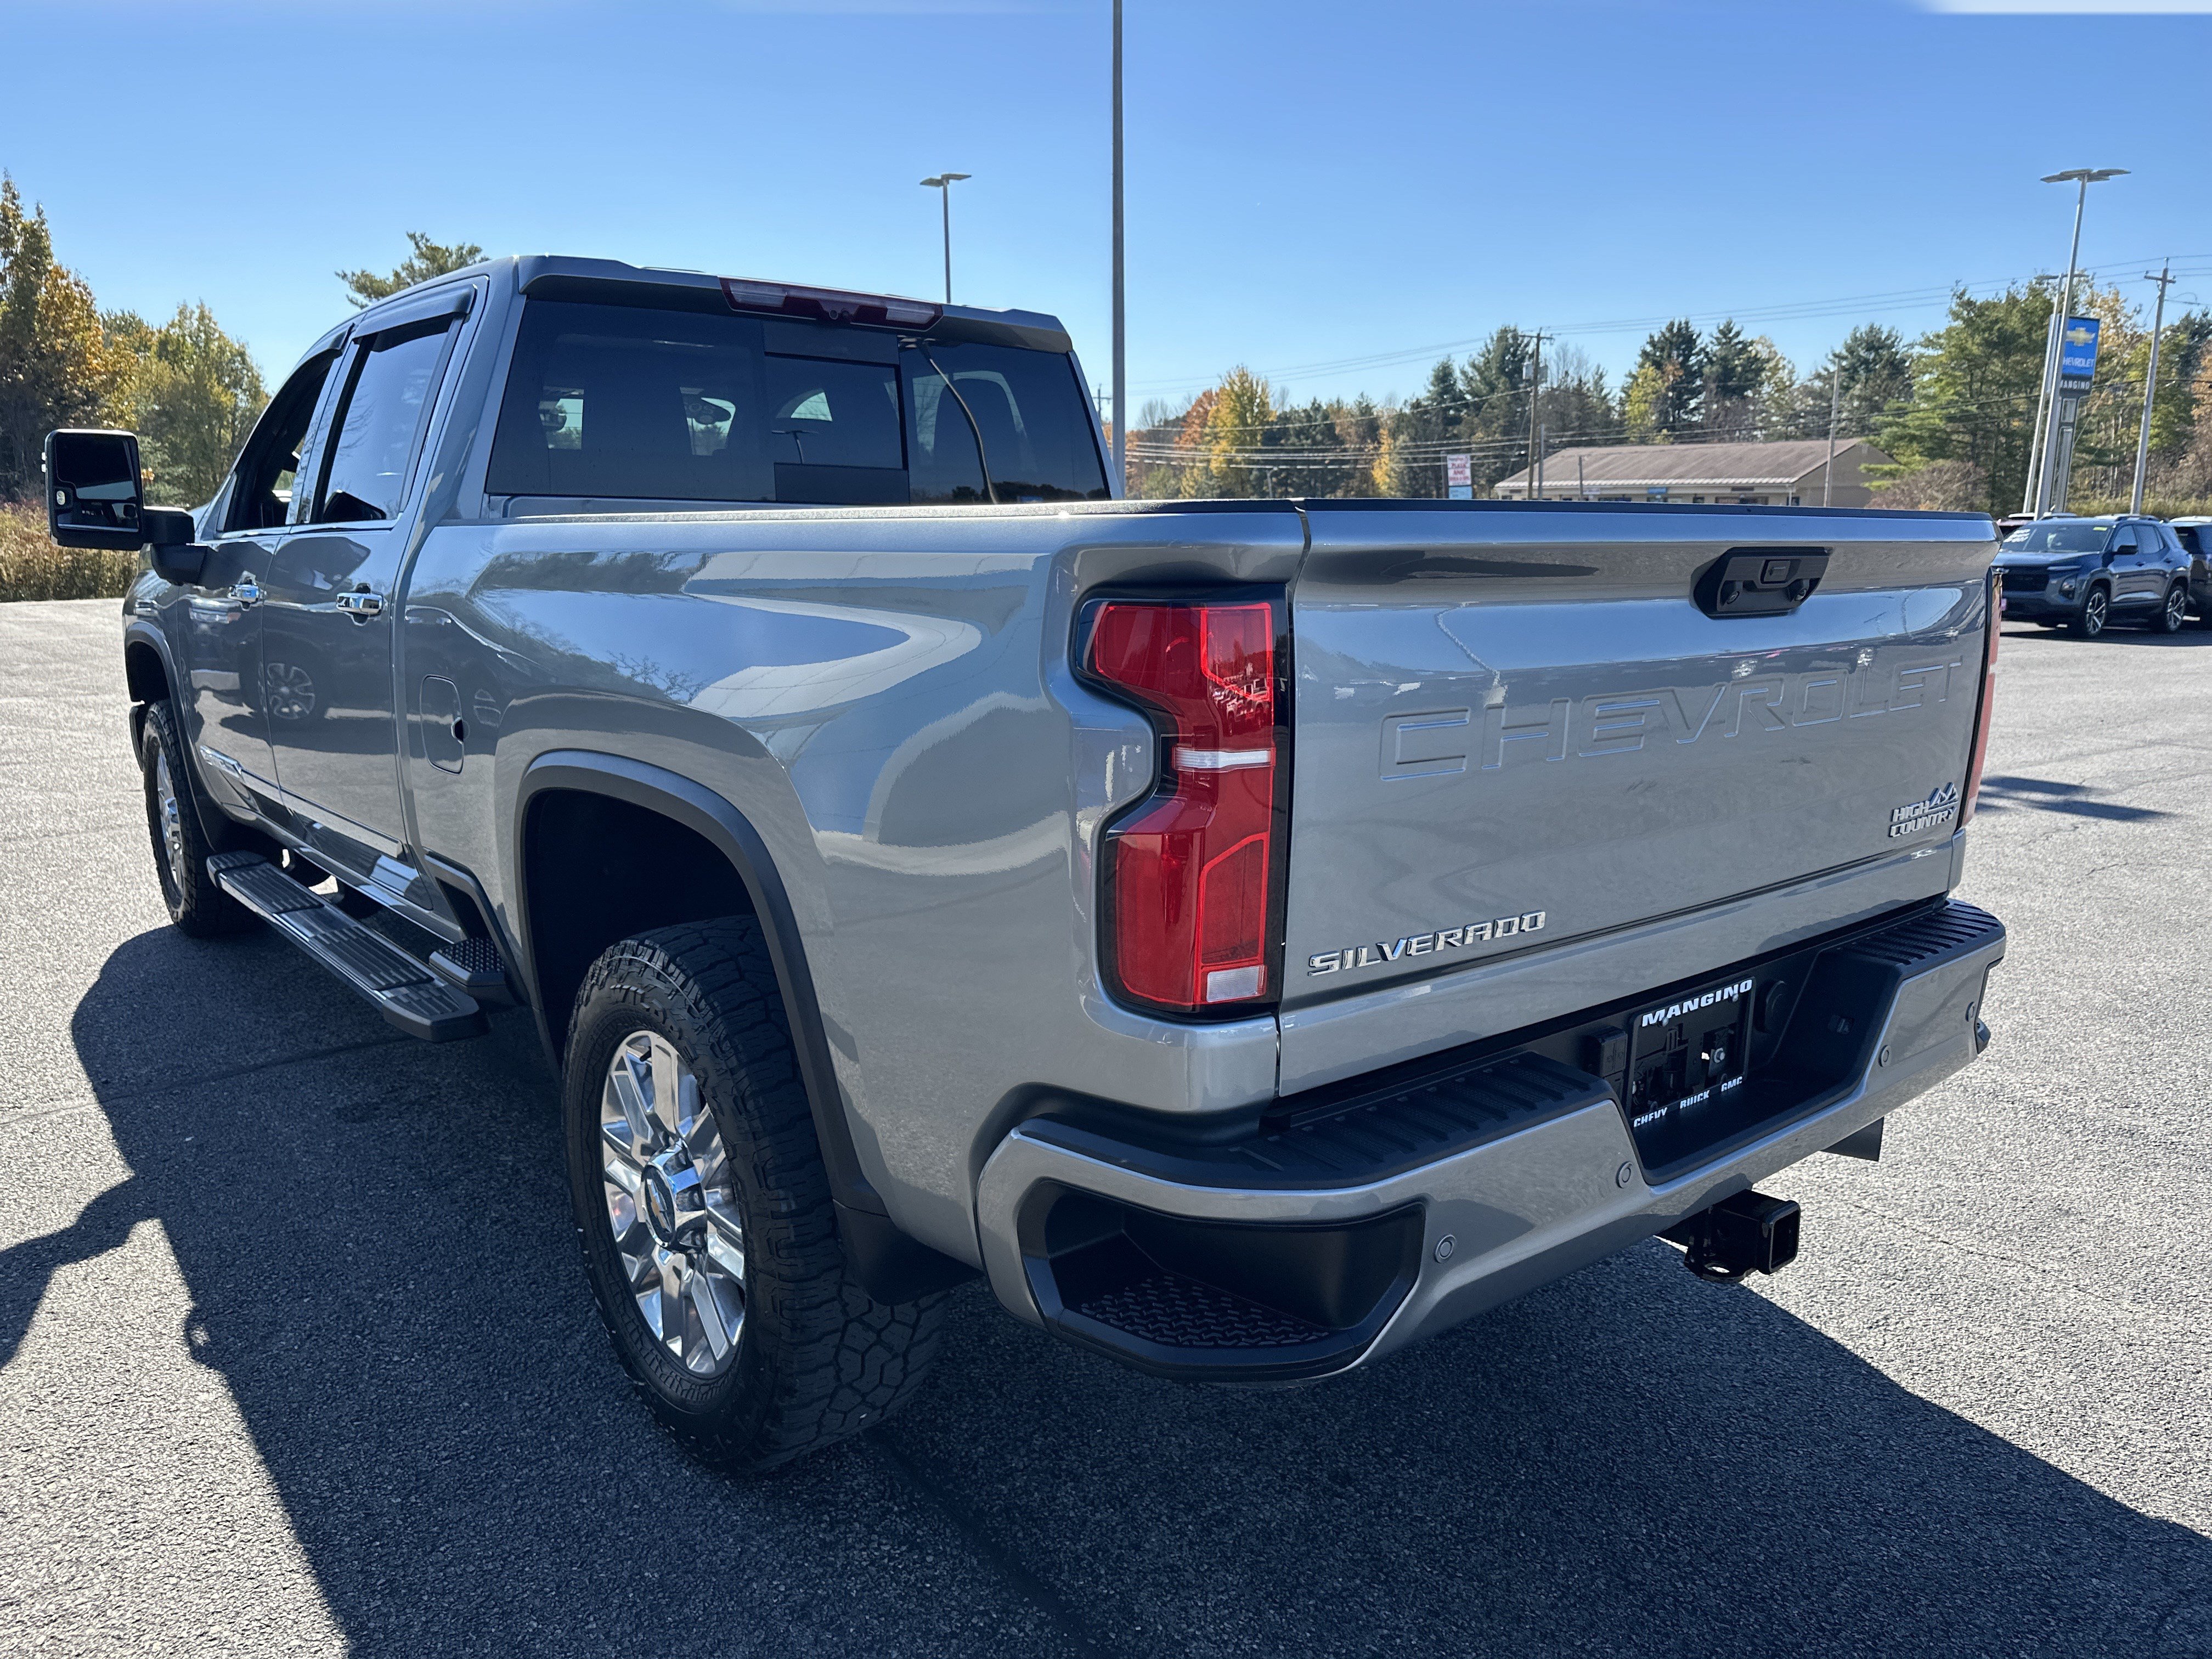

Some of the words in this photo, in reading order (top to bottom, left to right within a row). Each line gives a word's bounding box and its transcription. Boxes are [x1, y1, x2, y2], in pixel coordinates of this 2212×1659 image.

[1380, 654, 1963, 781] CHEVROLET
[1888, 806, 1957, 837] COUNTRY
[1891, 800, 1930, 822] HIGH
[1307, 910, 1547, 977] SILVERADO
[1642, 979, 1753, 1027] MANGINO
[1633, 1107, 1668, 1128] CHEVY
[1679, 1090, 1710, 1109] BUICK
[1720, 1076, 1743, 1092] GMC
